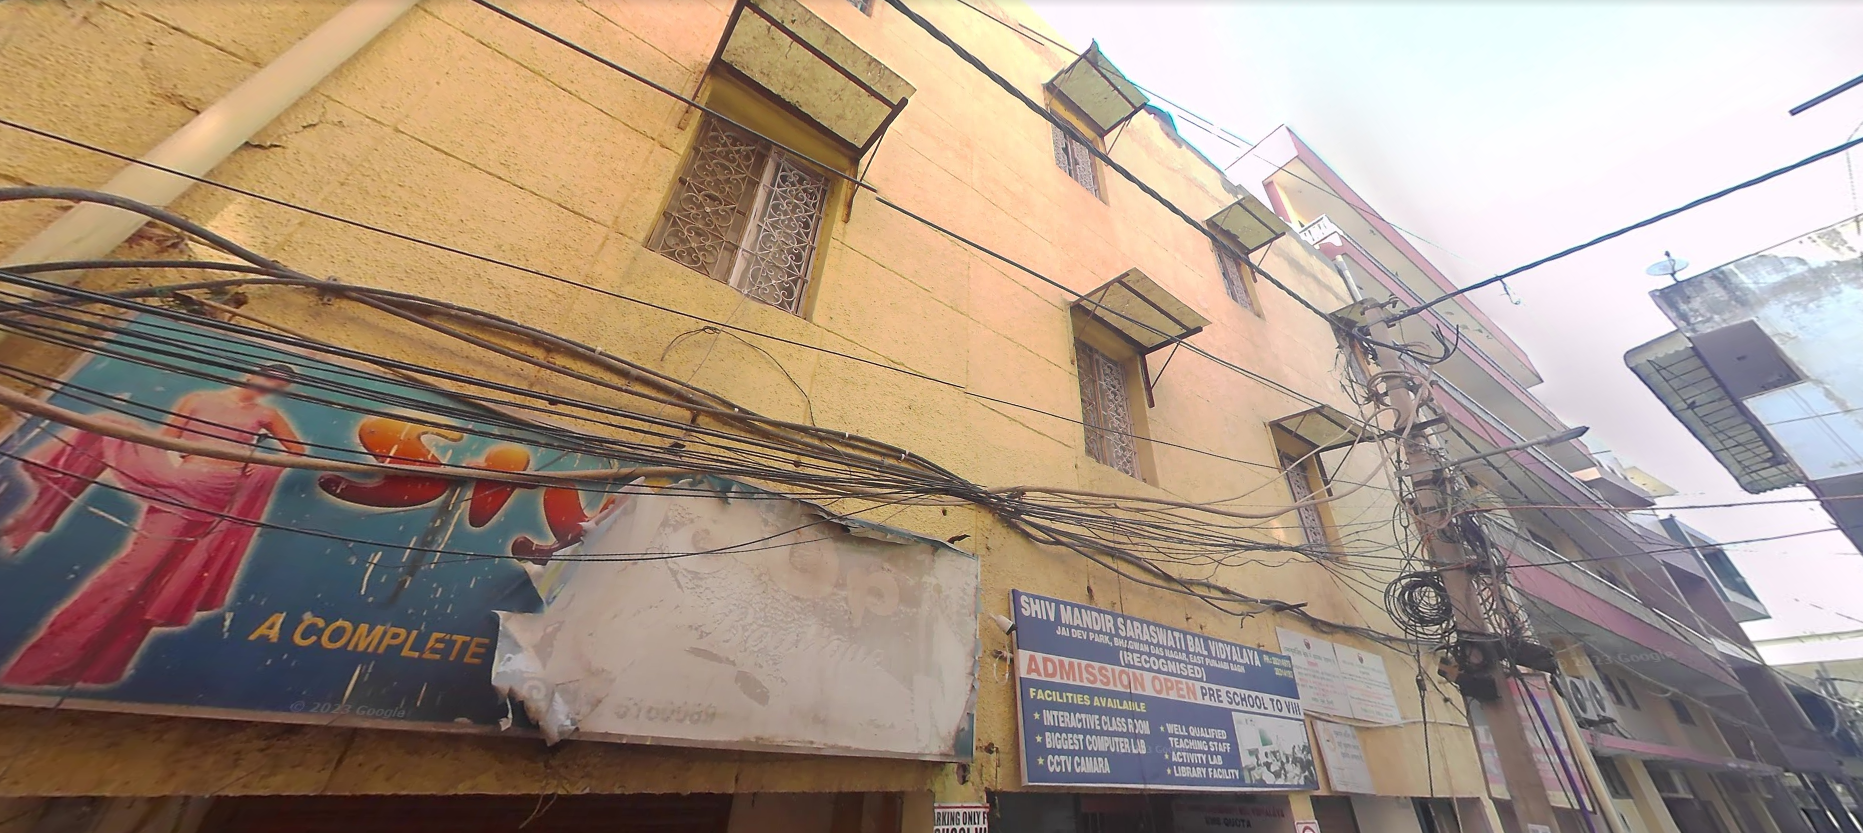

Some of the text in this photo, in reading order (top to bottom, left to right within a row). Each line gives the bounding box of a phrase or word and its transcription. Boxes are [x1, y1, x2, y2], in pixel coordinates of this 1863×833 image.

[247, 613, 491, 665] A COMPLETE
[1020, 595, 1056, 622] SHIV
[1060, 604, 1116, 634] MANDIR
[1117, 617, 1185, 650] SARASWATI
[1187, 634, 1208, 656] BAL
[1208, 640, 1262, 667] VIDYALAYA
[1056, 626, 1070, 637] JAI
[1072, 629, 1087, 640] DEV
[1090, 632, 1113, 646] PARK,
[1151, 645, 1164, 656] DAS
[1190, 654, 1205, 664] EAST
[1120, 650, 1207, 681] (RECOGNISED)
[1026, 654, 1302, 716] ADMISSION OPEN PRE SCHOOL TO VIII
[1029, 688, 1091, 706] FACILITIES
[1043, 709, 1101, 730] INTERACTIVE
[1101, 715, 1127, 732] CLASS
[1166, 723, 1227, 740] WELL QUALIFIED
[1045, 732, 1147, 754] BIGGEST COMPUTER LAB
[1169, 737, 1231, 753] TEACHING STAFF
[1047, 754, 1110, 774] CCTV CAMARA
[1172, 752, 1223, 765] ACTIVITY LAB
[1173, 766, 1240, 780] LIBRARY FACILITY
[962, 811, 981, 826] ONLY
